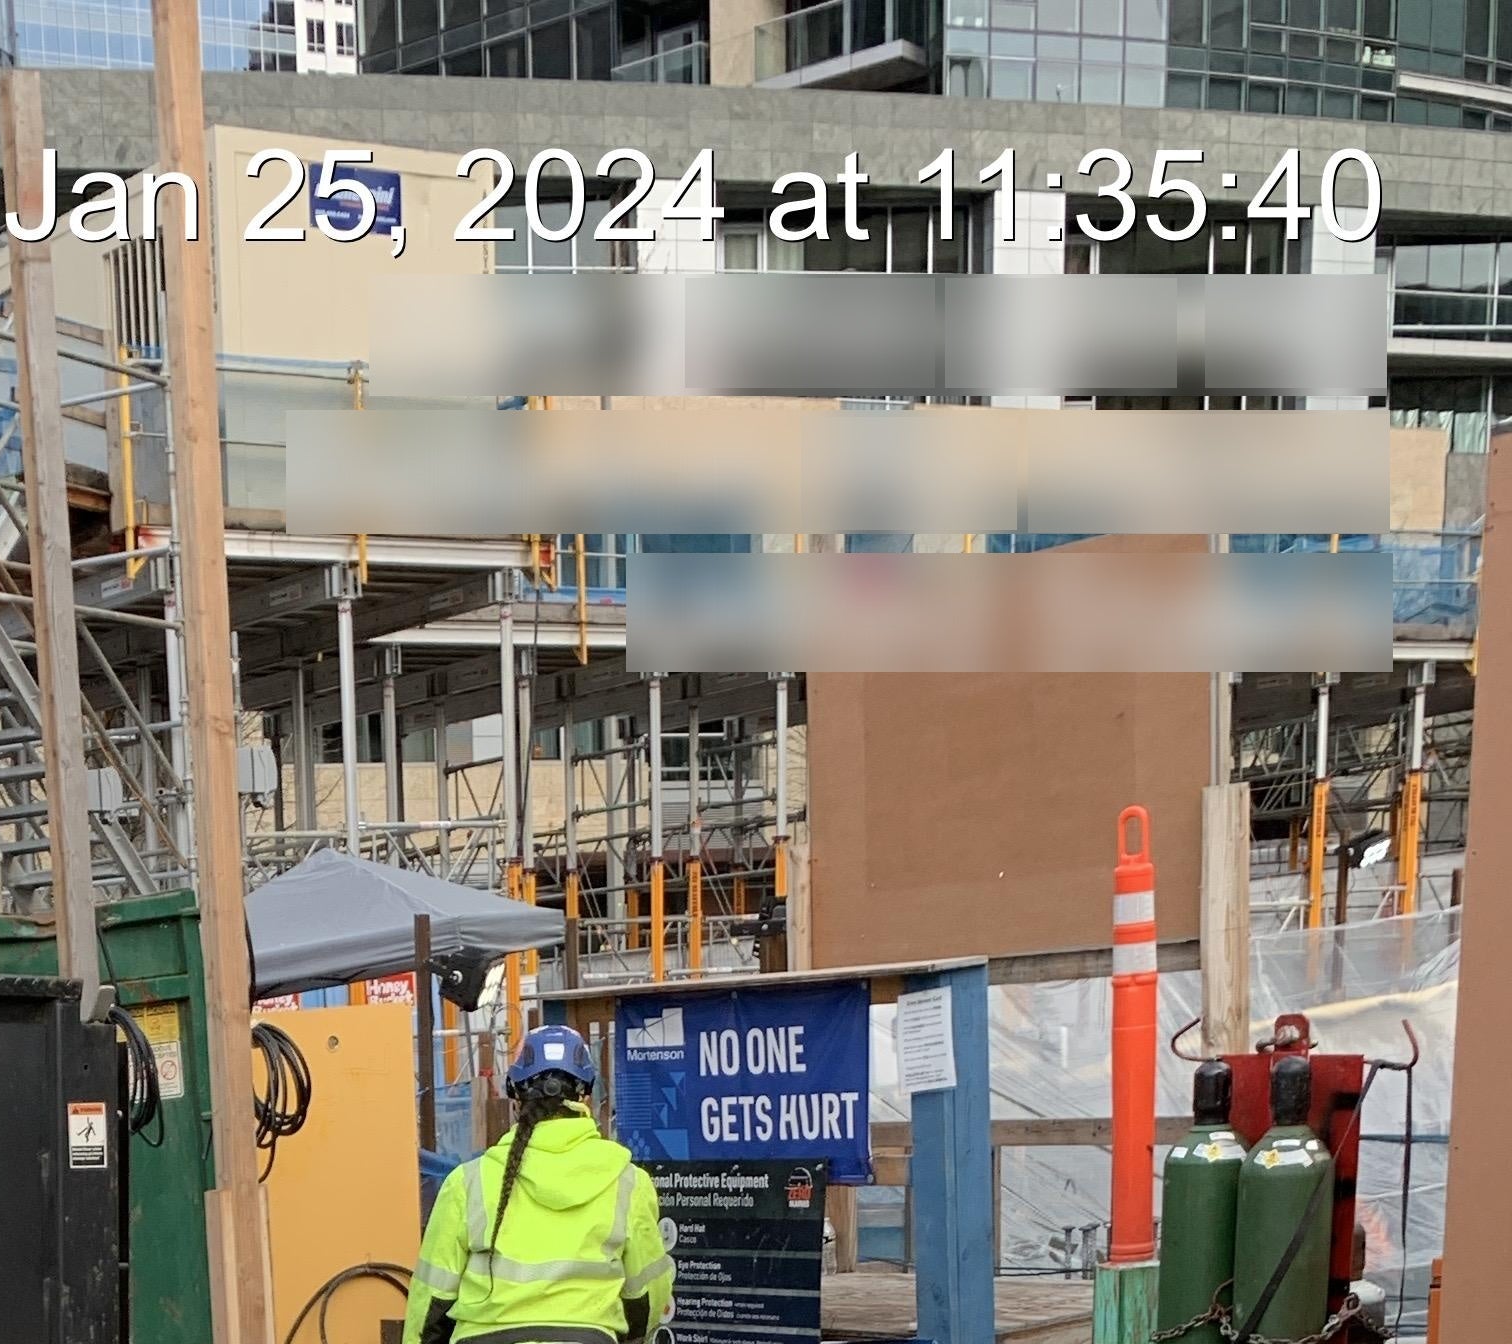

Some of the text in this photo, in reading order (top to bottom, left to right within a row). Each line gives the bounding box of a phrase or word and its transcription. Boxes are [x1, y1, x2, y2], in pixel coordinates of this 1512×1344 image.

[626, 1049, 685, 1062] Mortenson
[699, 1026, 807, 1077] NO ONE
[700, 1092, 859, 1142] GETS HURT
[674, 1172, 720, 1188] Protective
[721, 1172, 769, 1192] Equipment
